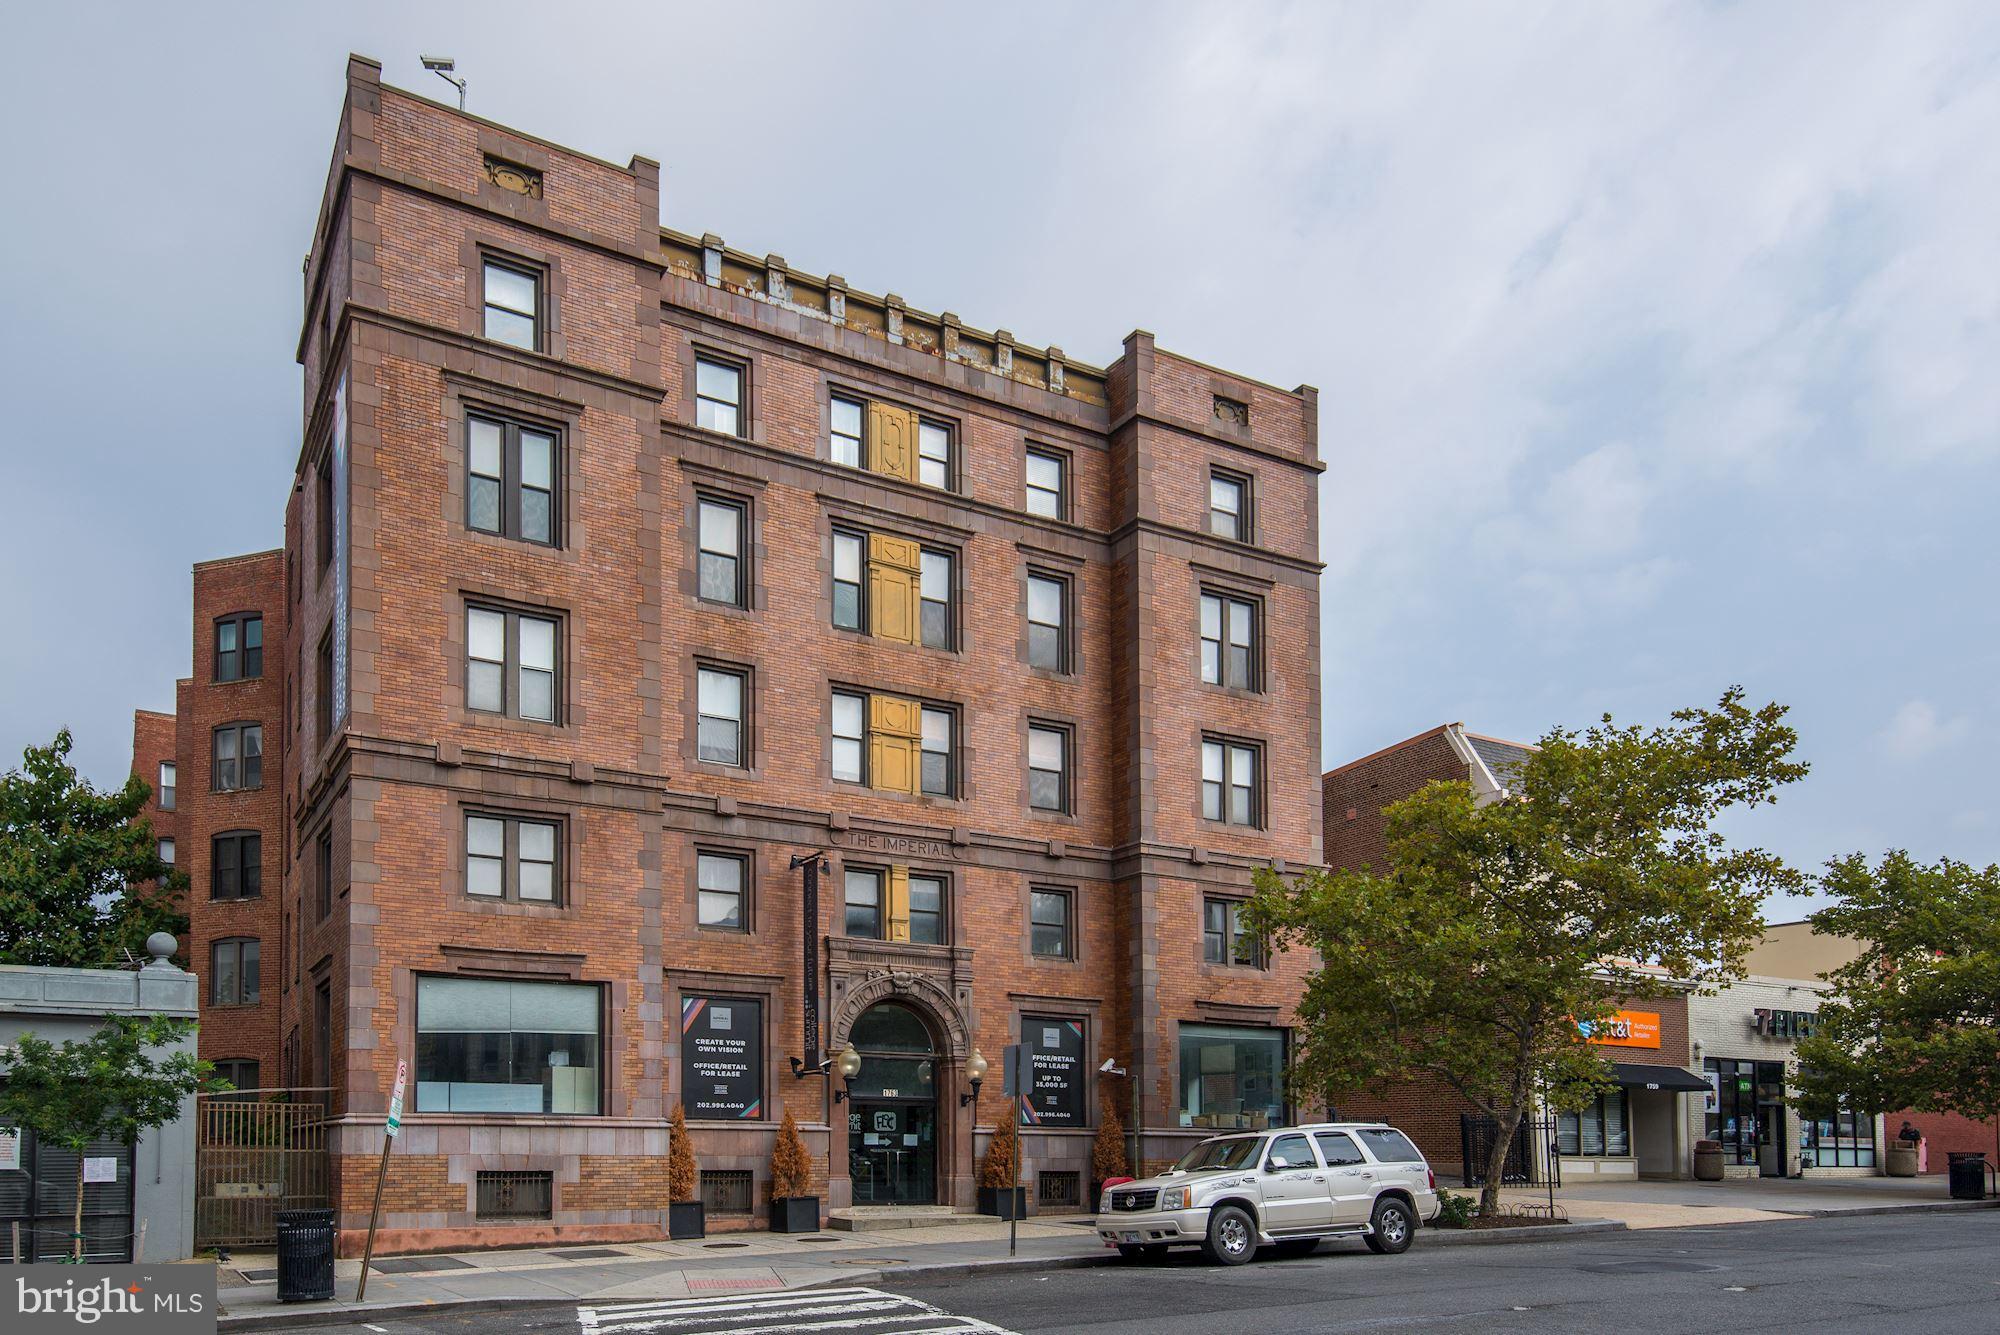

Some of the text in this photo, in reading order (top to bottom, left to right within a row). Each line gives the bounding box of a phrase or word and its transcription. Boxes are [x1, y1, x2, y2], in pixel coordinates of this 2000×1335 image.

[848, 832, 949, 857] THE IMPERIAL
[1601, 1015, 1632, 1038] t&t
[1032, 1054, 1076, 1062] FFICE/RETAIL
[693, 1062, 748, 1070] OFFICE/RETAIL
